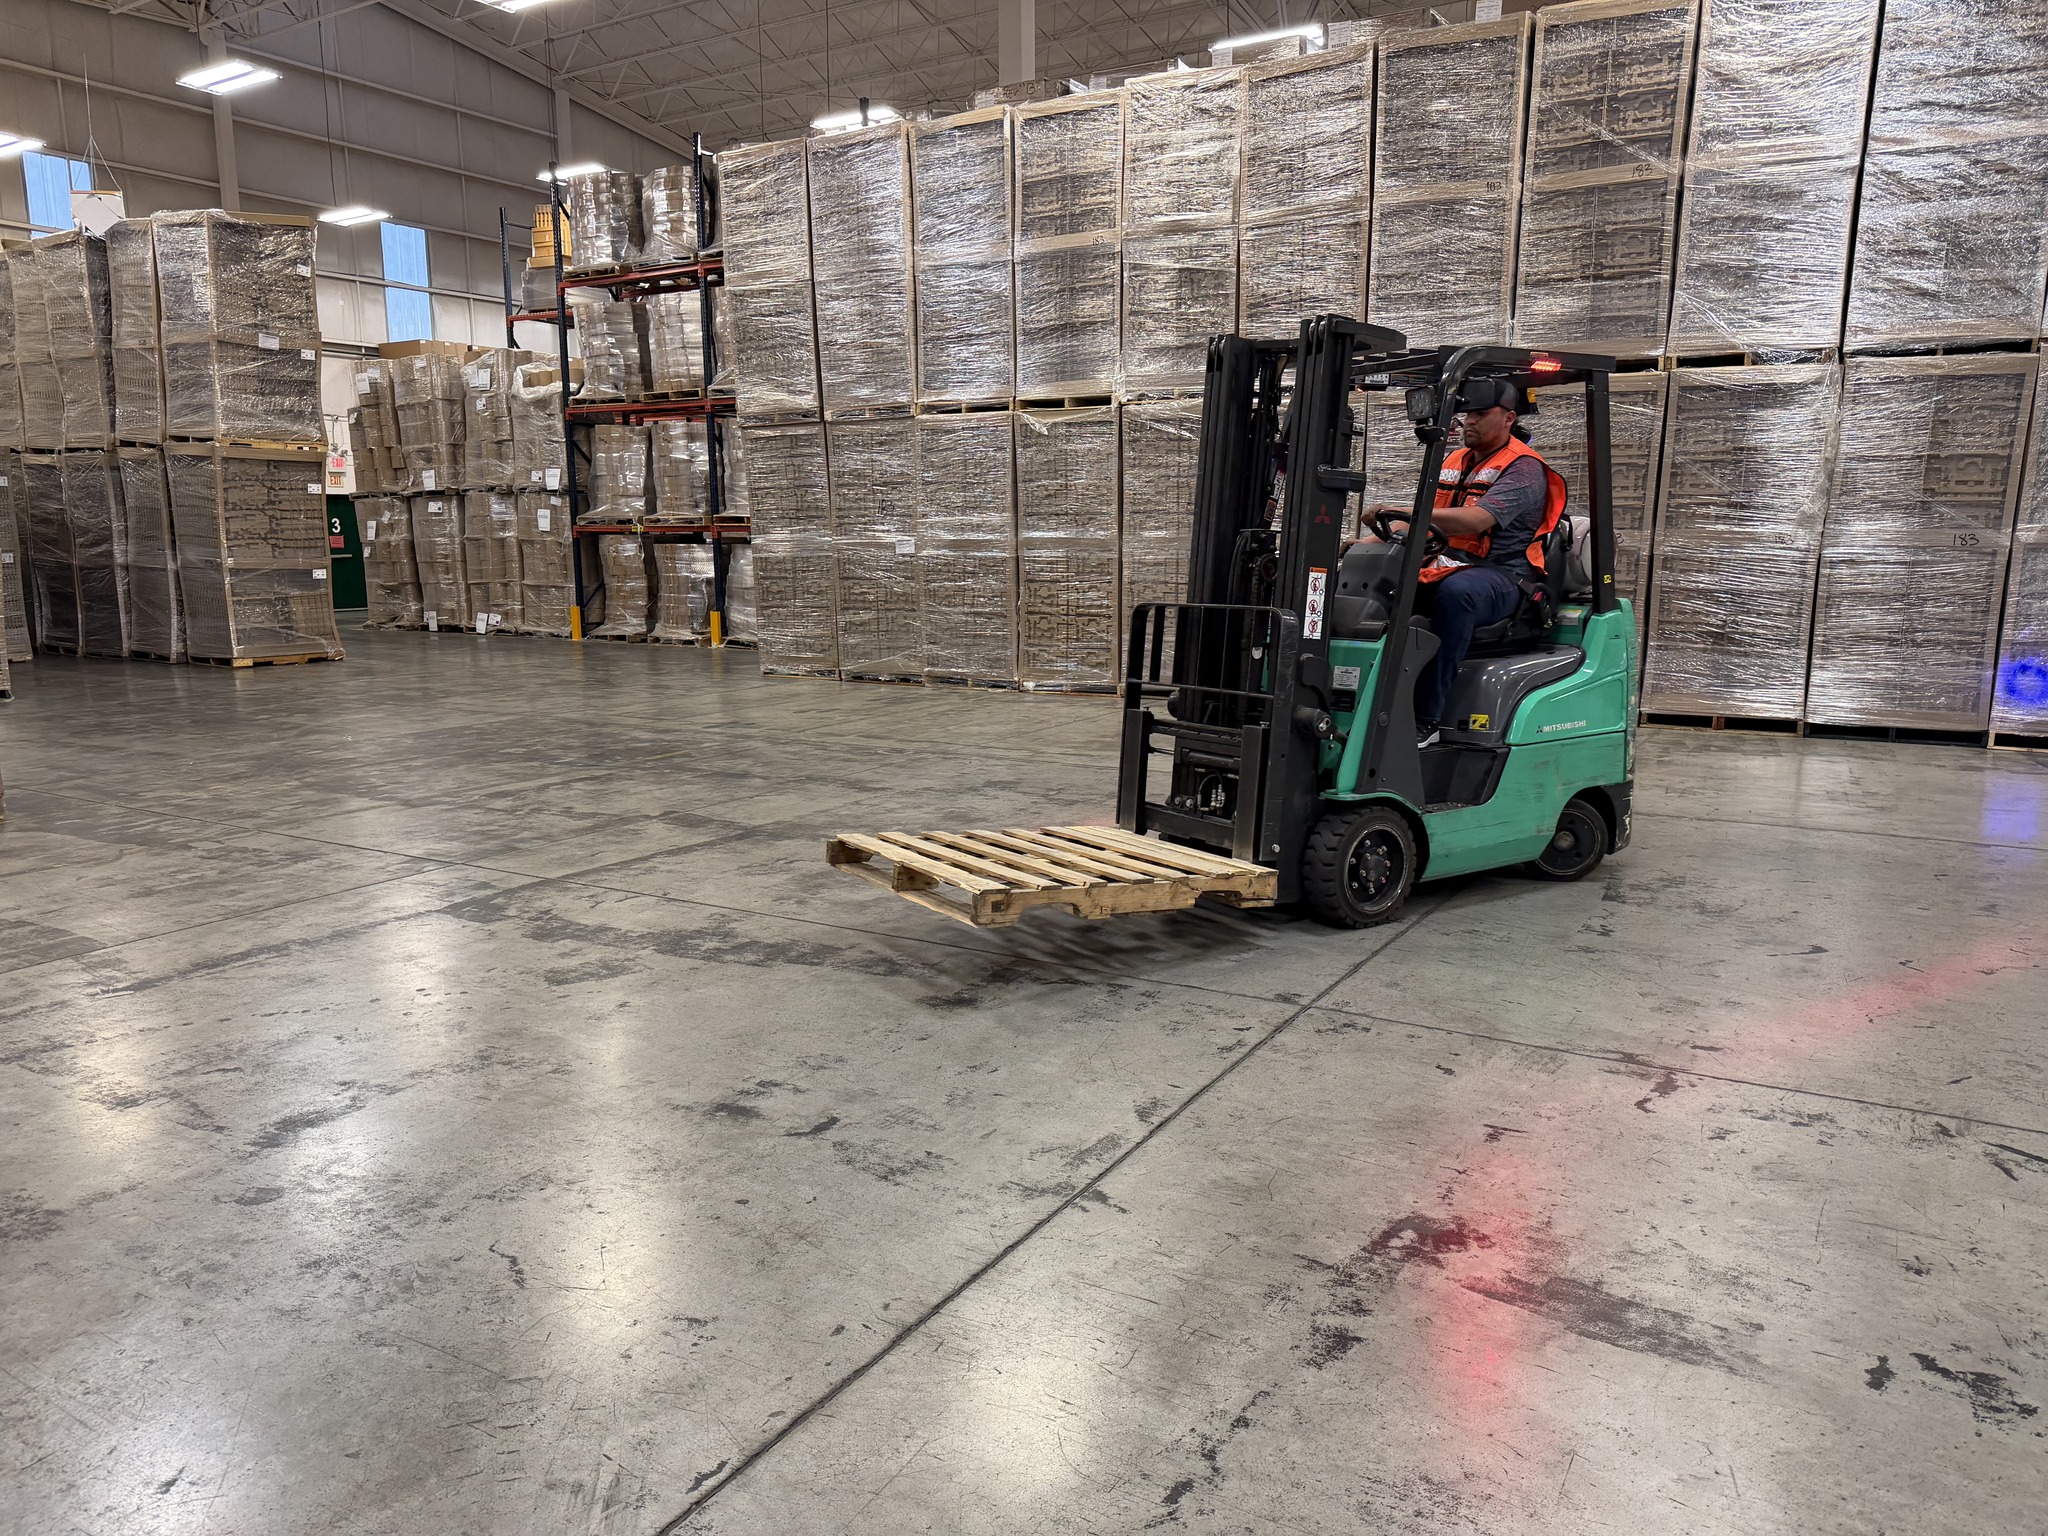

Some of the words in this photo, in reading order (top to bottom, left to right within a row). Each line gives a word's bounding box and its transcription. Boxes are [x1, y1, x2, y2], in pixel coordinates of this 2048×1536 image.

[1632, 163, 1653, 178] 183
[332, 457, 345, 468] EXIT
[330, 475, 341, 485] EXIT
[331, 517, 341, 533] 3
[1953, 533, 1980, 546] 183
[1543, 720, 1586, 732] MITSUBISHI
